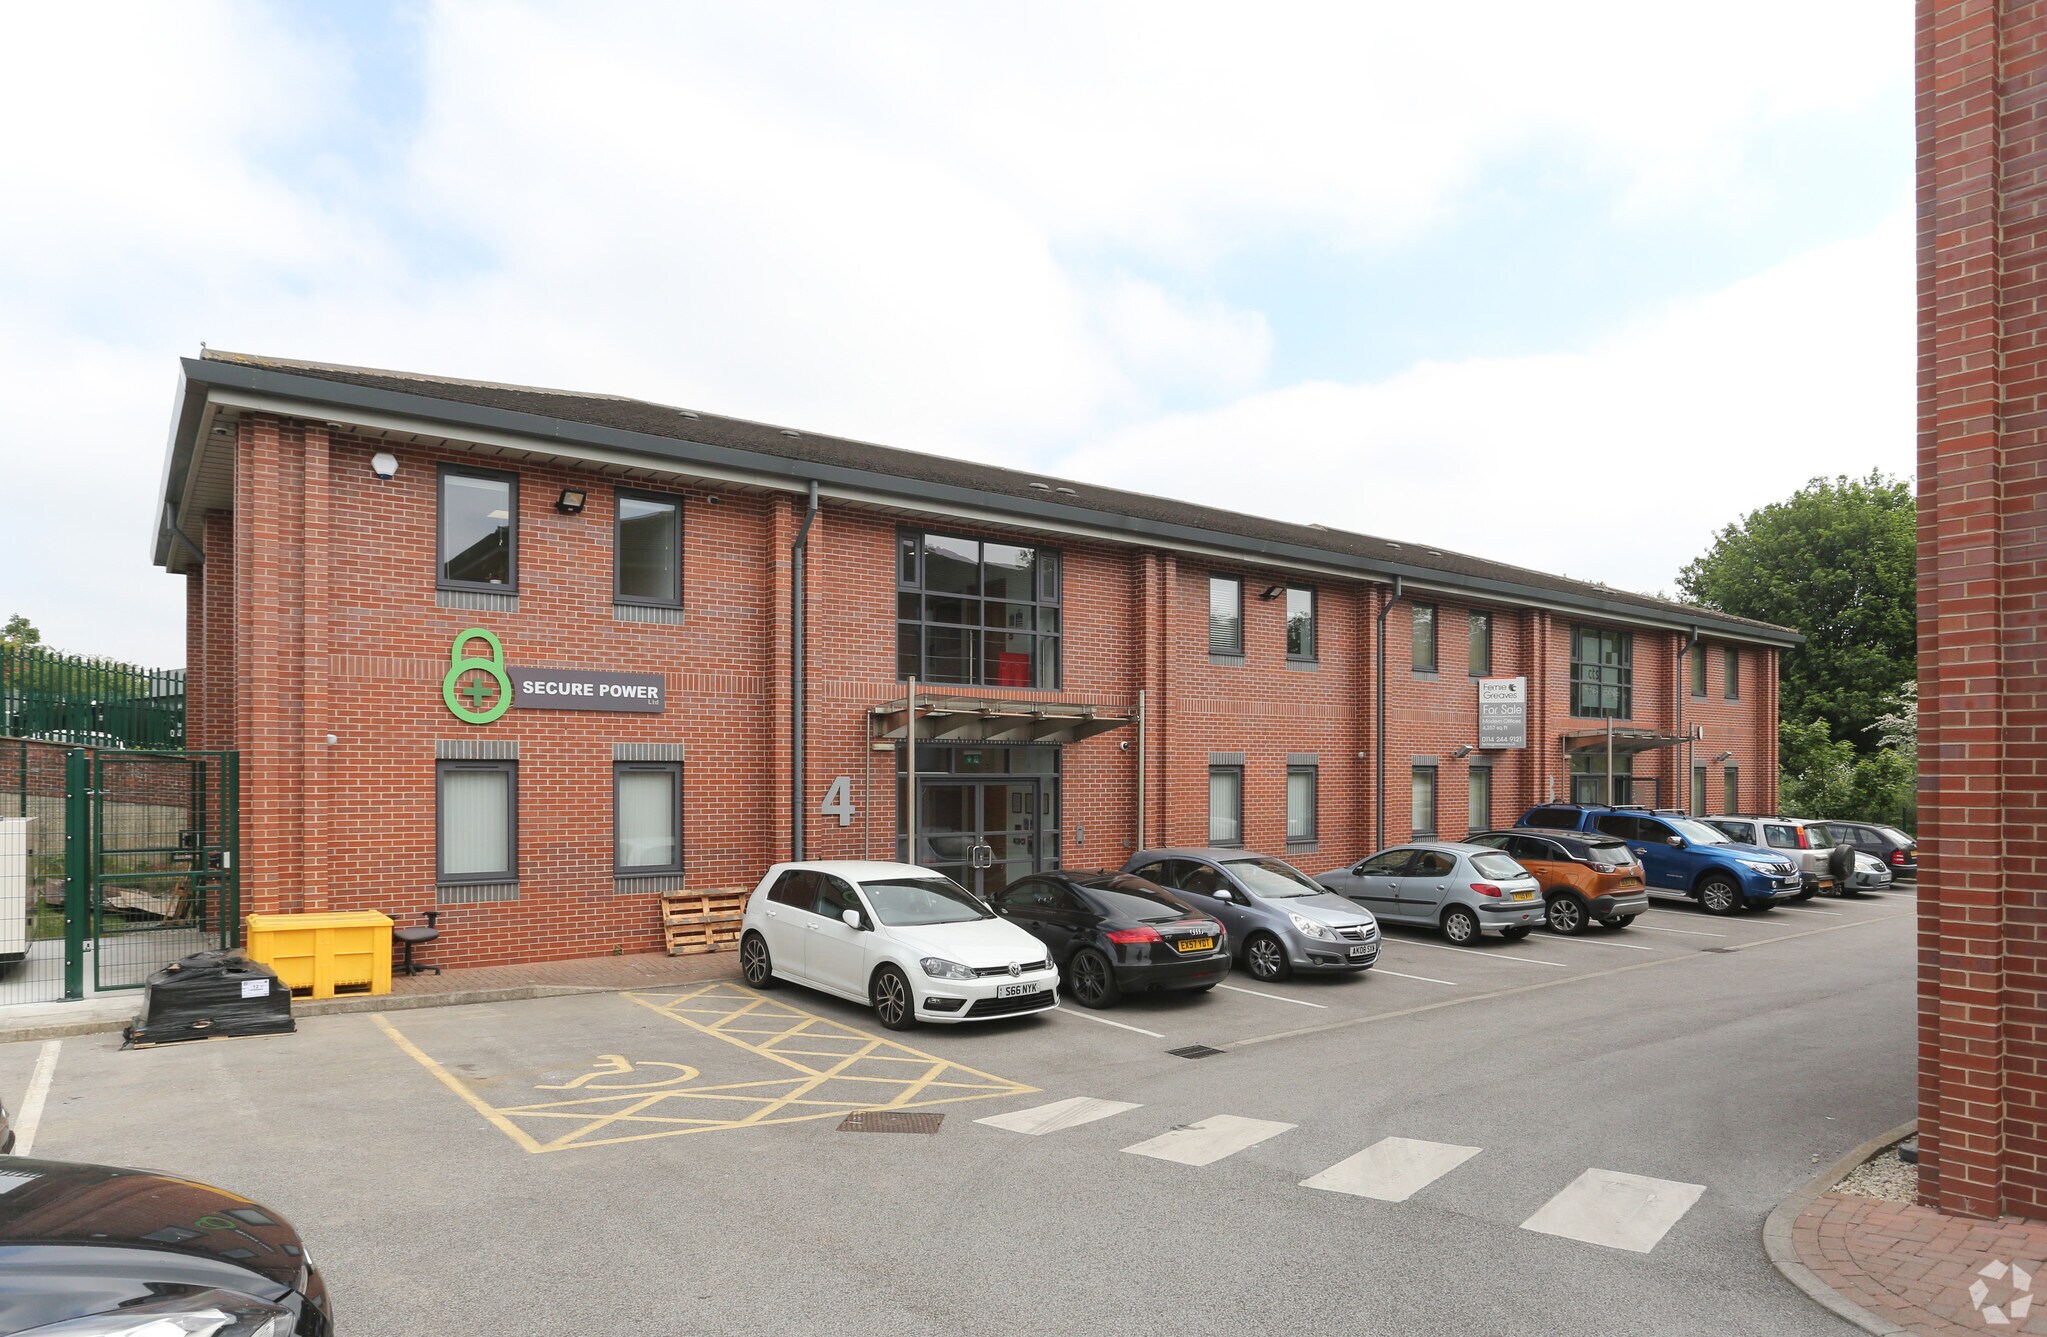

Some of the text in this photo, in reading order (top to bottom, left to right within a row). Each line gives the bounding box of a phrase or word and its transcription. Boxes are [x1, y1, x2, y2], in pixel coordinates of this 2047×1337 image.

[522, 680, 659, 699] SECURE POWER
[1483, 683, 1507, 691] Fernie
[1483, 691, 1518, 699] Greaves
[1483, 703, 1523, 715] For Sale
[821, 775, 856, 827] 4
[1181, 939, 1197, 950] EX57
[1005, 982, 1037, 997] S66 NYK
